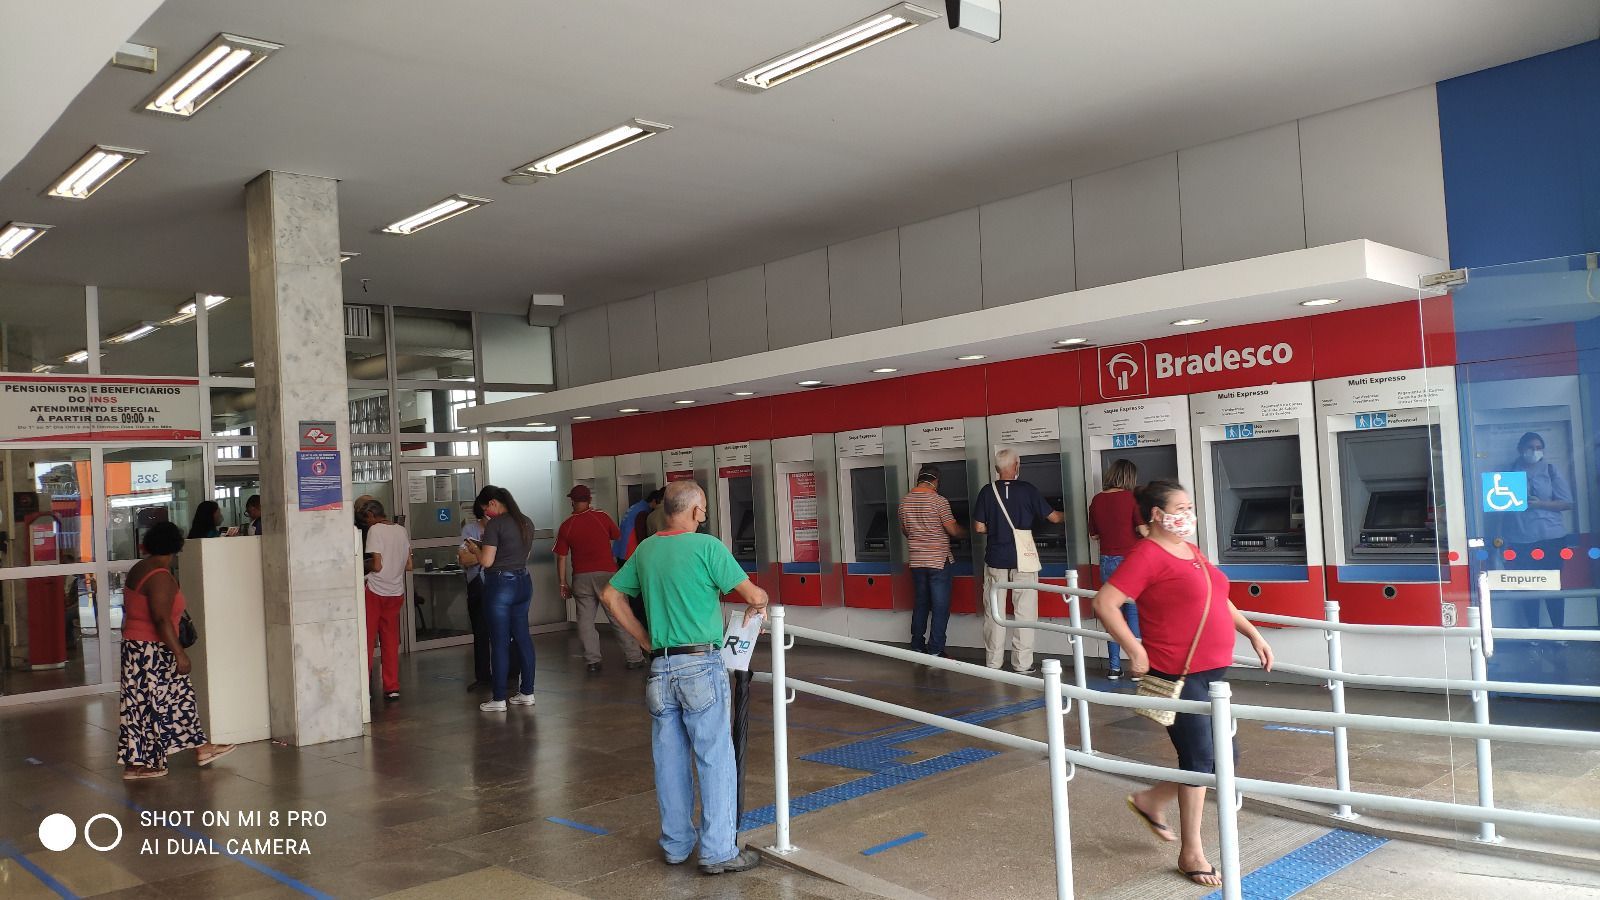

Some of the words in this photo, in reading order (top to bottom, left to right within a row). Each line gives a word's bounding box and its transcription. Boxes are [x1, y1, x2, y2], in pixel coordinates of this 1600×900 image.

[1155, 342, 1293, 379] Bradesco
[1348, 378, 1368, 386] Multi
[1370, 376, 1406, 384] Expresso
[5, 385, 87, 393] PENSIONISTAS
[100, 386, 180, 394] BENEFICIÁRIOS
[1218, 391, 1235, 400] Multi
[1236, 390, 1269, 398] Expresso
[122, 413, 144, 423] 09:00
[1500, 574, 1547, 584] Empurre
